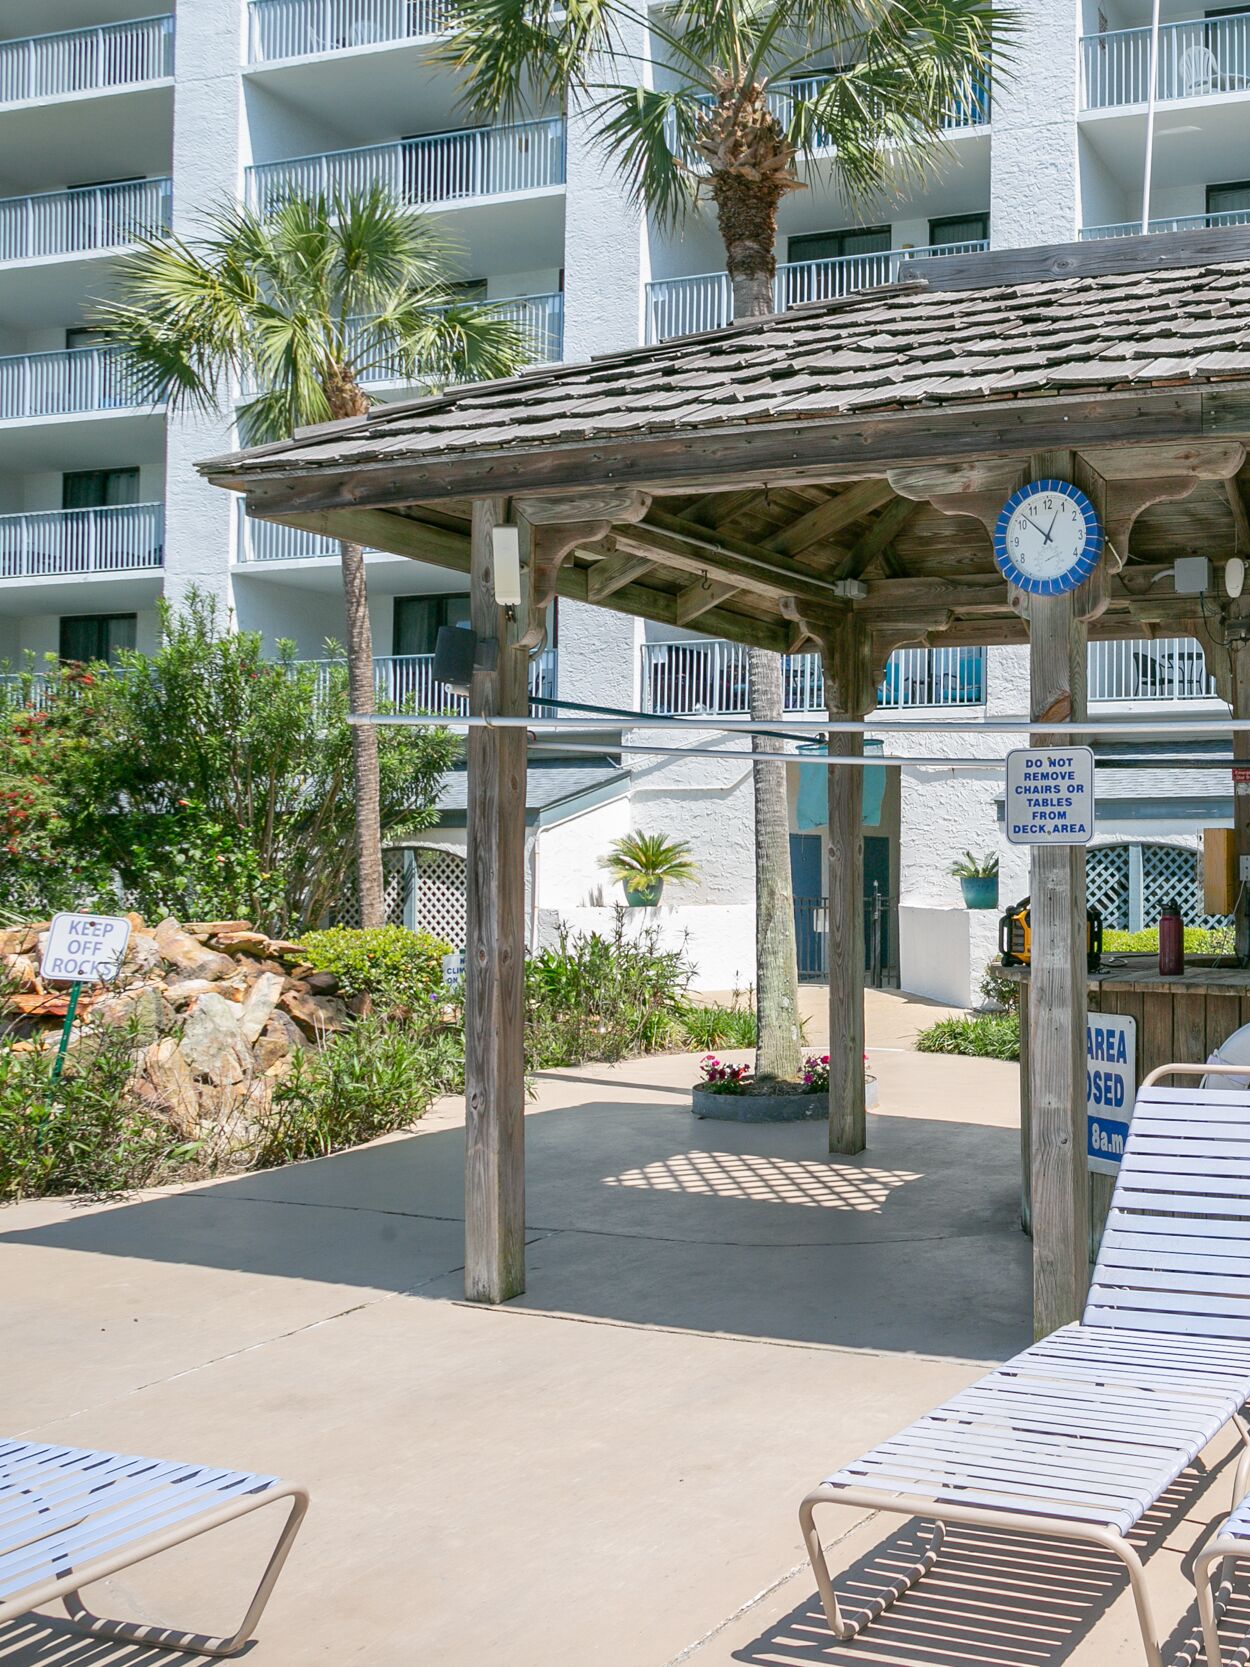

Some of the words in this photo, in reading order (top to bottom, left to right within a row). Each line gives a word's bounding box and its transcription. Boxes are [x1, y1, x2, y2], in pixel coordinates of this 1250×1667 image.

[1043, 499, 1052, 510] 12
[1061, 502, 1065, 512] 1
[1029, 506, 1038, 516] 11
[1072, 511, 1077, 521] 2
[1018, 520, 1027, 530] 10
[1078, 529, 1083, 540] 3
[1014, 537, 1019, 547] 9
[1073, 548, 1078, 557] 4
[1020, 553, 1025, 563] 8
[1026, 759, 1042, 768] DO
[1049, 758, 1073, 767] NOT
[1024, 771, 1075, 781] REMOVE
[1015, 785, 1061, 794] CHAIRS
[1067, 784, 1084, 793] OR
[1027, 798, 1072, 807] TABLES
[1032, 811, 1067, 820] FROM
[1014, 825, 1046, 834] DECK
[1052, 824, 1086, 833] AREA
[68, 920, 113, 937] KEEP
[68, 940, 103, 955] OFF
[52, 958, 111, 975] ROCKS
